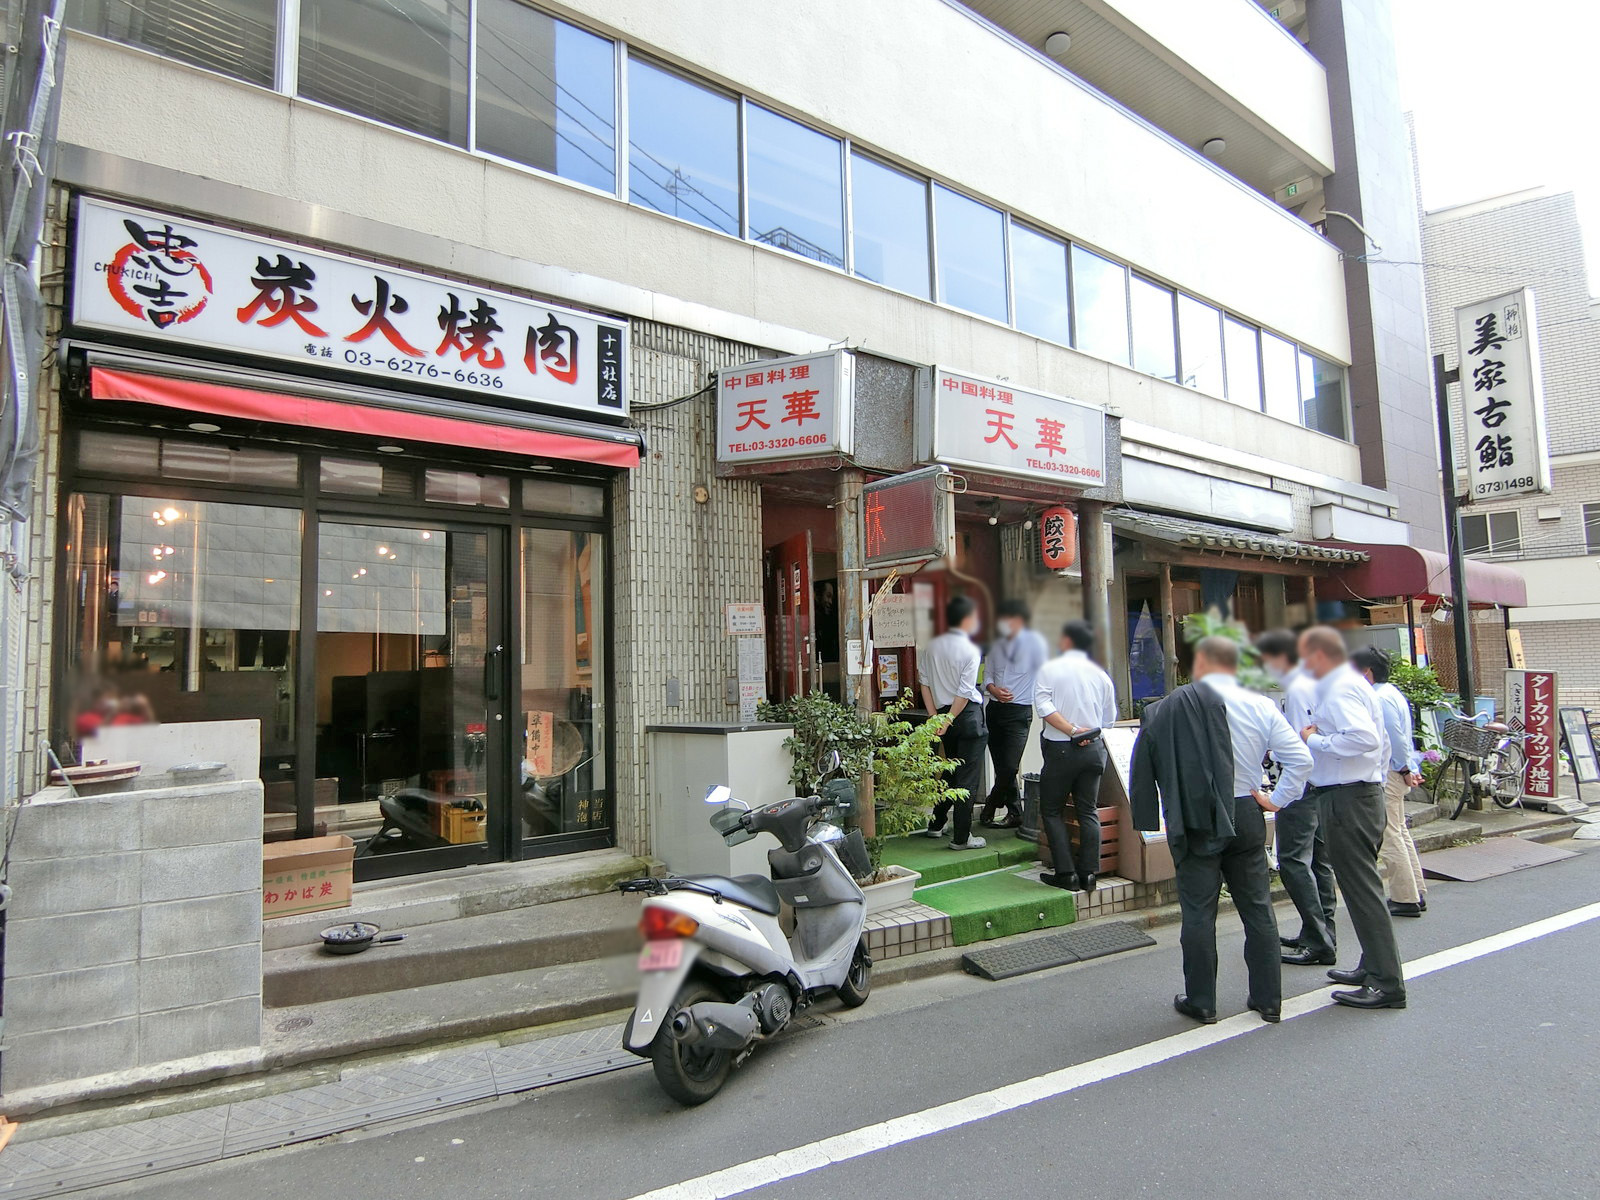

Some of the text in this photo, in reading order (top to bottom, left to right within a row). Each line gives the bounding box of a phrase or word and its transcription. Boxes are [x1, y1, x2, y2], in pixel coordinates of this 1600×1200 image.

[94, 262, 159, 283] CHUKICHI
[123, 219, 198, 329] 忠吉
[237, 254, 580, 385] 炭火焼肉
[304, 343, 503, 390] 電話 03-6276-6636
[601, 334, 618, 401] 十二社店
[725, 365, 810, 390] 中国料理
[735, 389, 820, 431] 天華
[942, 377, 1014, 406] 中国料理
[1468, 313, 1514, 473] 美家古鮨
[728, 434, 827, 453] TEL:03-3320-6606
[983, 408, 1067, 458] 天華
[1026, 458, 1101, 479] TEL:03-3320-6606
[1475, 476, 1534, 494] (373)1498
[1044, 514, 1065, 559] 餃子
[1529, 674, 1551, 794] タレカツ・カップ地酒
[263, 881, 333, 904] わかば炭
